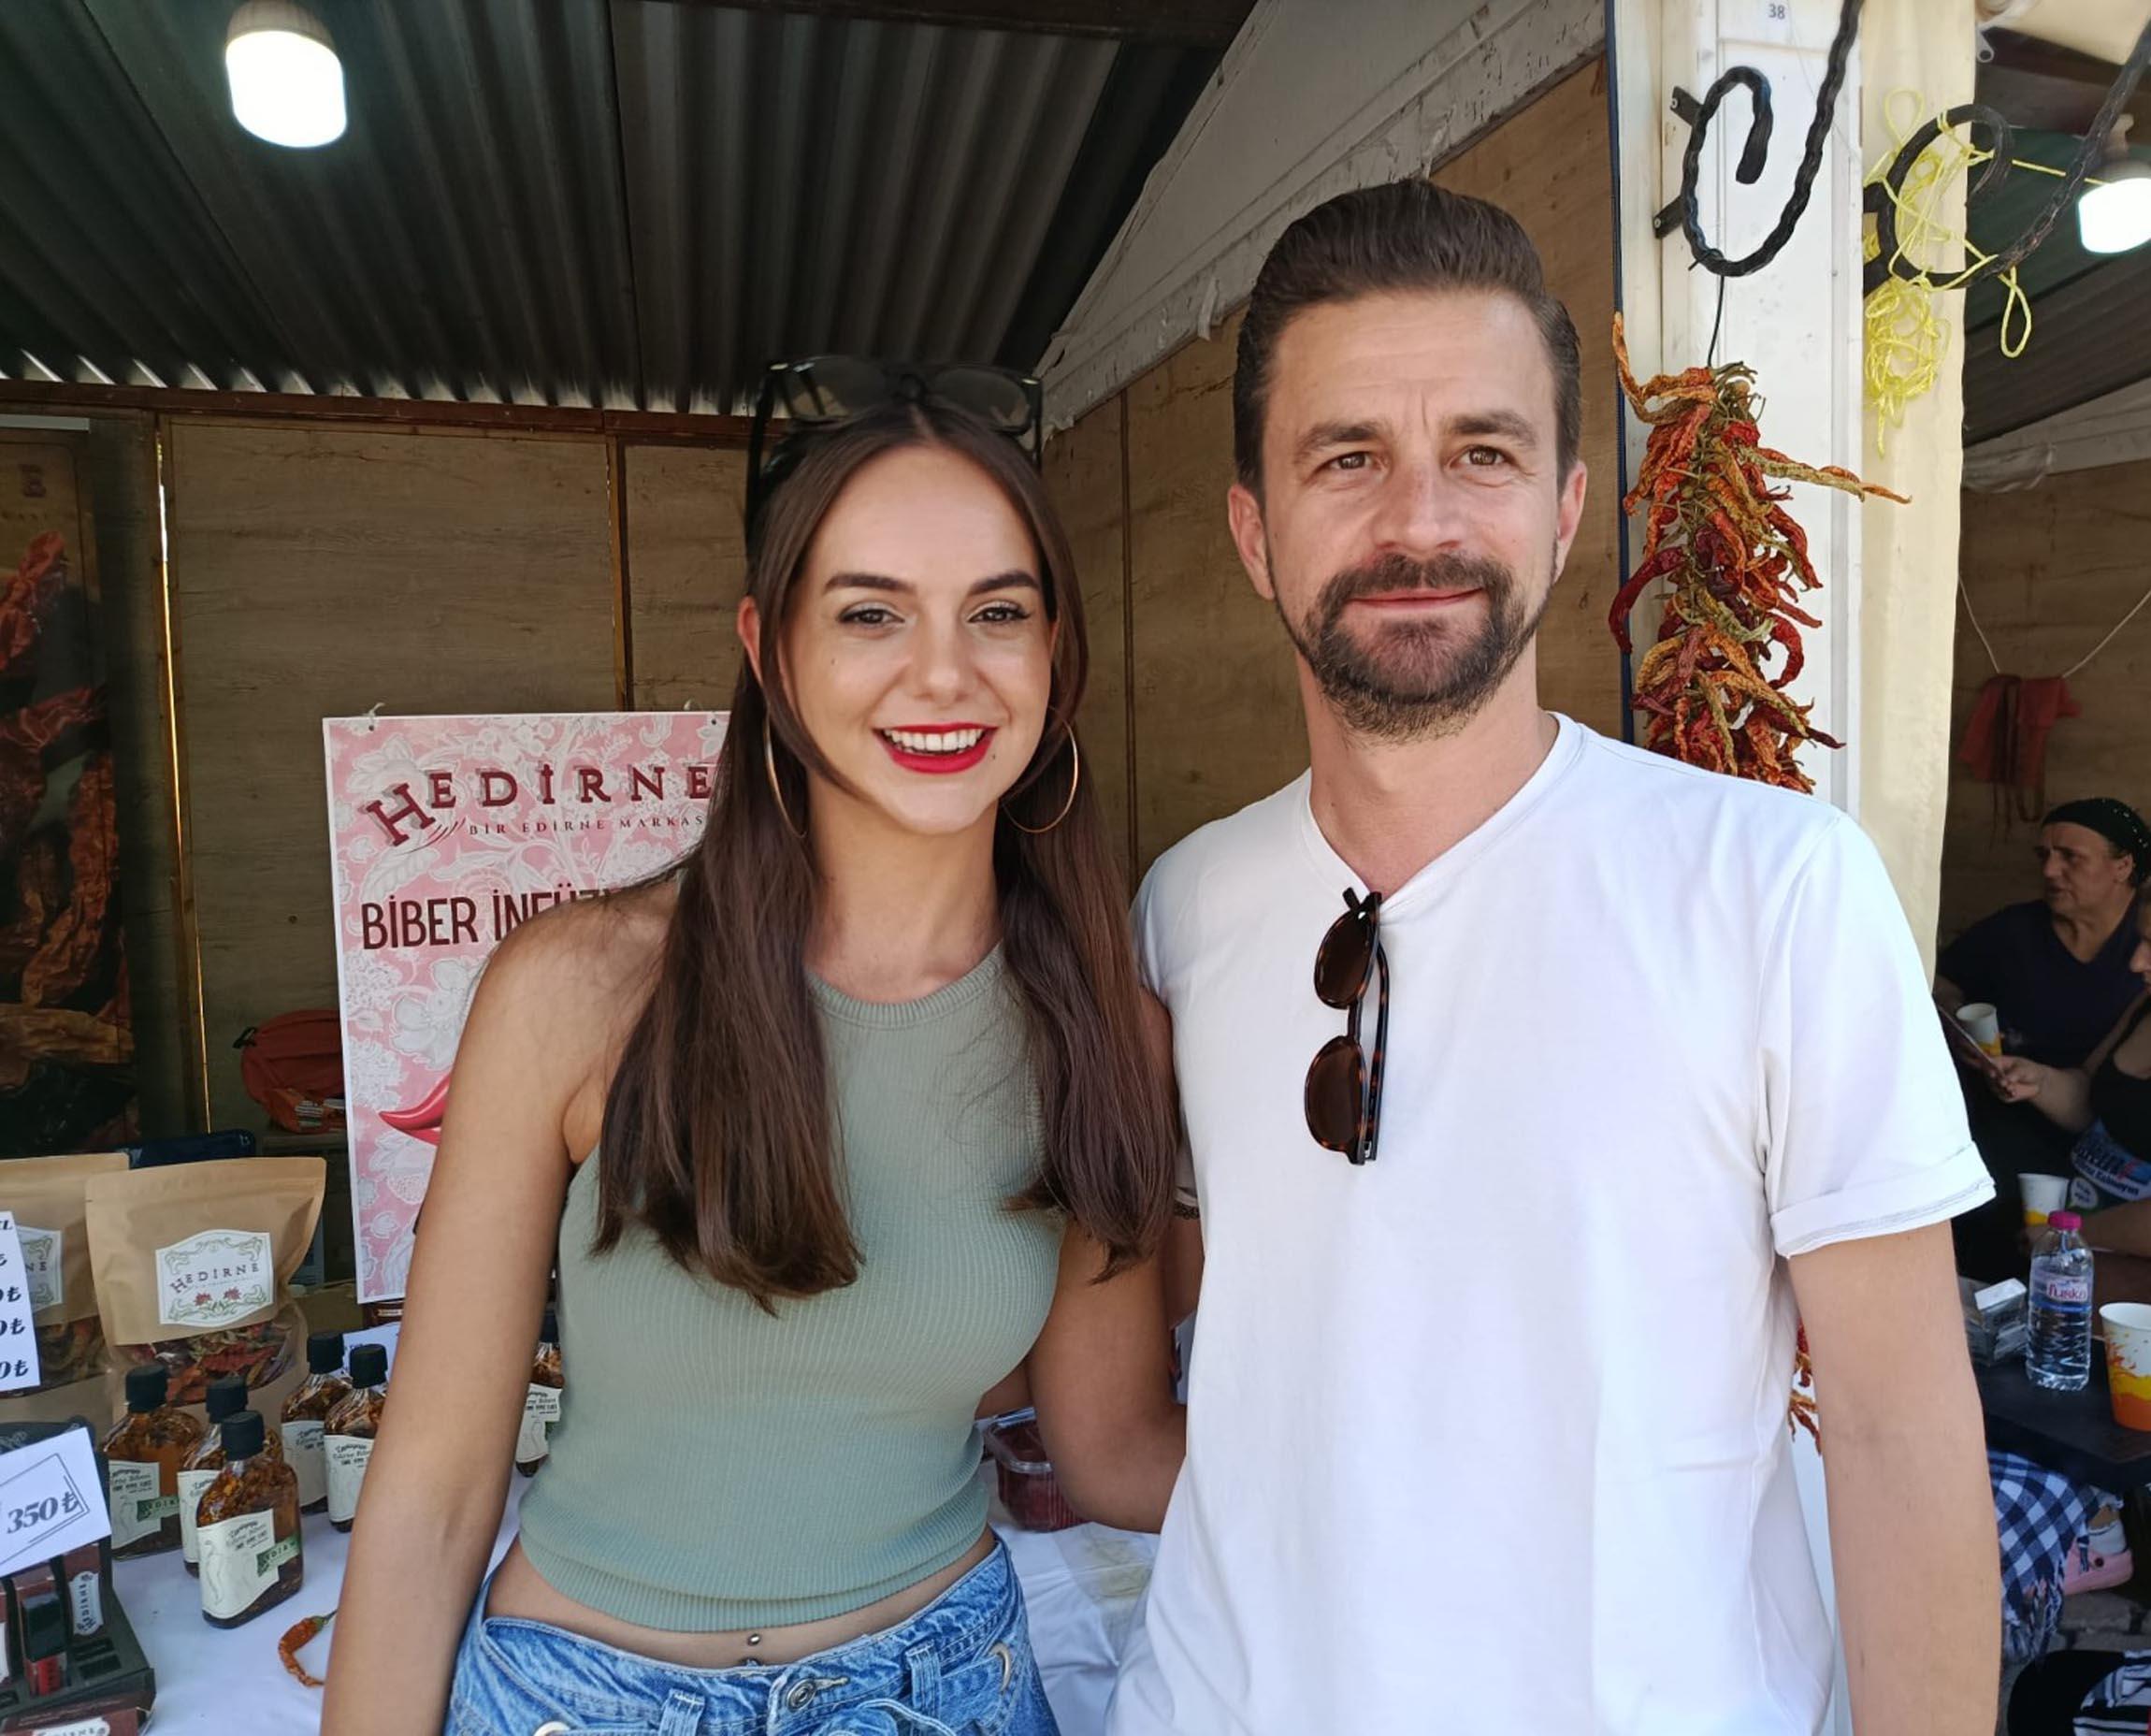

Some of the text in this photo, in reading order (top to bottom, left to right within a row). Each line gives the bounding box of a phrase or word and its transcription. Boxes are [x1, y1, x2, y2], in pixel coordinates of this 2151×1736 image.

[1768, 3, 1785, 20] 38
[620, 816, 703, 829] MARKAS
[361, 894, 479, 949] BİBER
